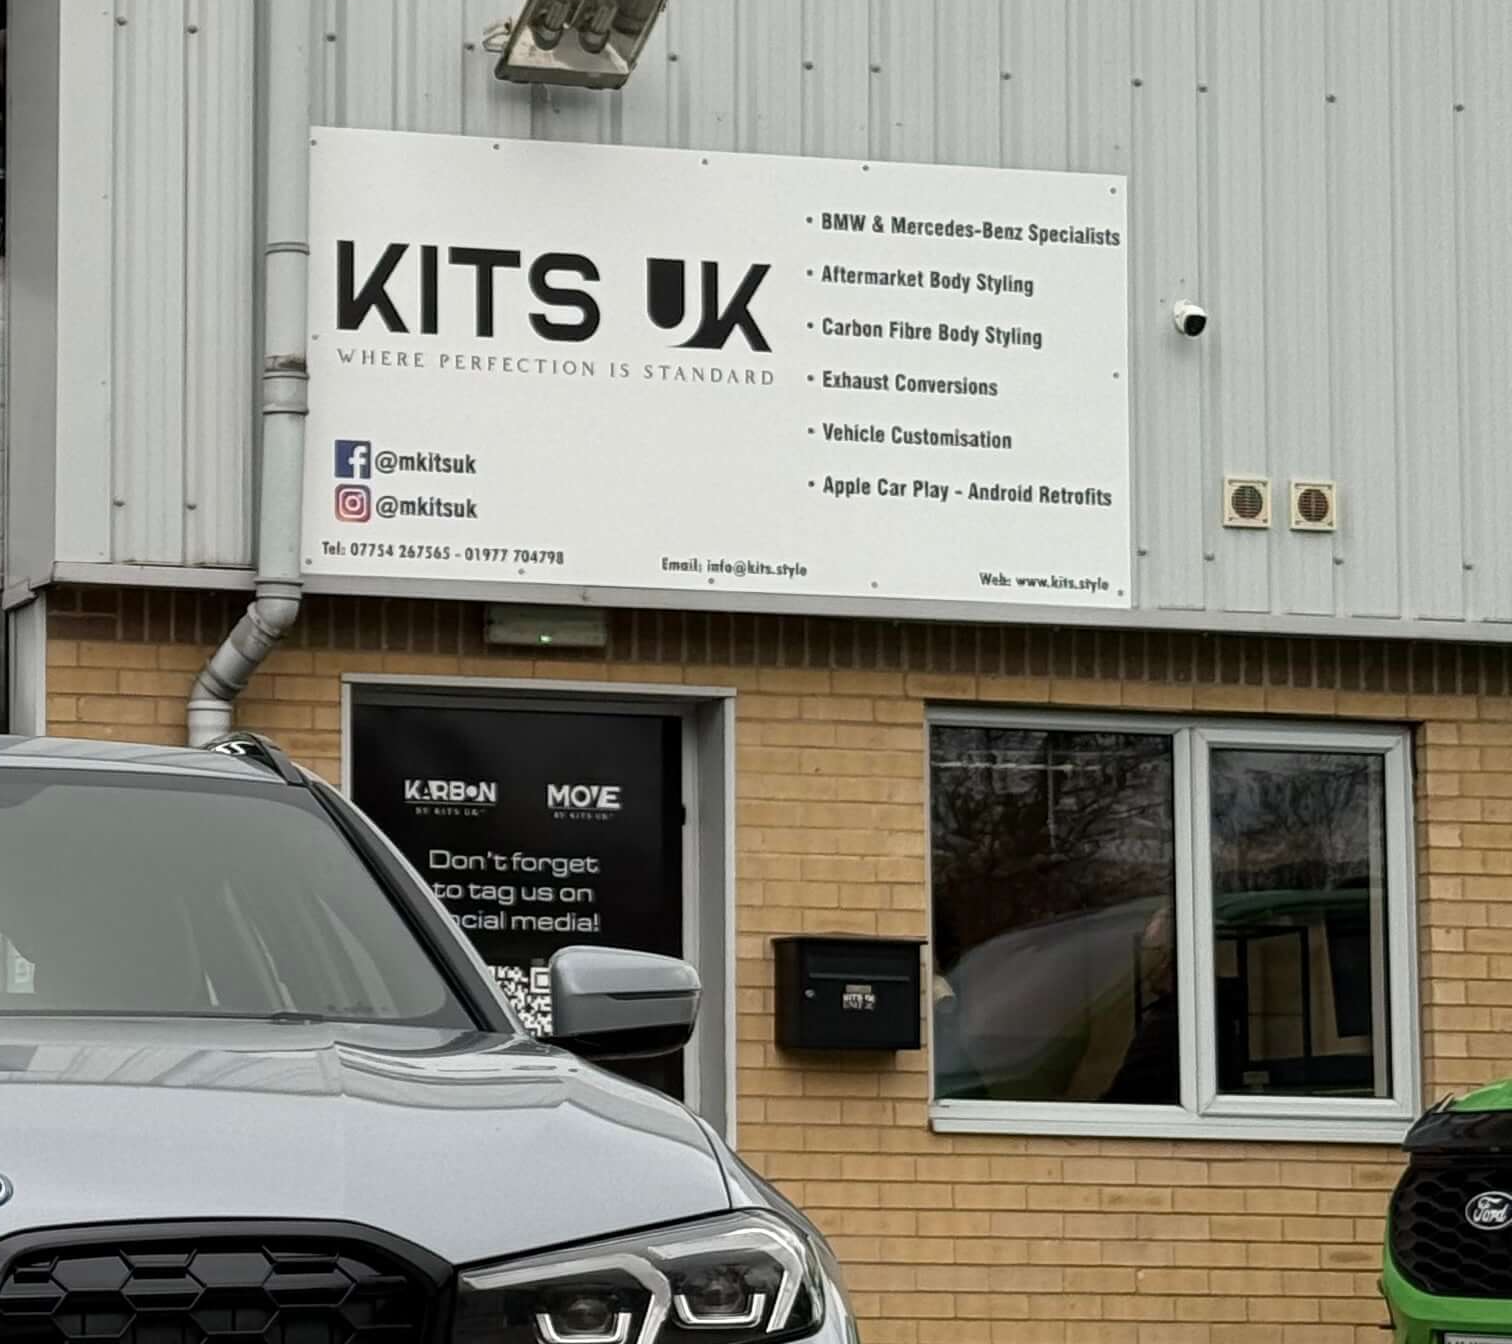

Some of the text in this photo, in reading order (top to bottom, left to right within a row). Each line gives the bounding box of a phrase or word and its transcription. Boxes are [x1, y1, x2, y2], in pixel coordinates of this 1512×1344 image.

[822, 213, 1121, 247] BMW & Mercedes-Benz Specialists
[821, 265, 1034, 298] Aftermarket Body Styling
[336, 239, 773, 353] KITS UK
[822, 317, 1042, 350] Carbon Fibre Body Styling
[337, 348, 775, 385] WHERE PERFECTION IS STANDARD
[822, 370, 998, 397] Exhaust Conversions
[822, 423, 1012, 449] Vehicle Customisation
[375, 450, 477, 474] @mkitsuk
[822, 476, 871, 498] Apple
[877, 477, 907, 497] Car
[913, 480, 949, 503] Play
[968, 483, 1033, 503] Android
[1039, 486, 1112, 507] Retrofits
[376, 495, 478, 519] @mkitsuk
[321, 541, 346, 556] Tel:
[350, 543, 394, 558] 07754
[398, 544, 450, 561] 267565
[464, 547, 508, 563] 01977
[513, 549, 565, 565] 704798
[707, 559, 808, 579] info@kits.style
[1016, 575, 1109, 593] www.kits.style
[404, 779, 497, 802] KARBON
[547, 783, 622, 809] MOVE
[429, 849, 600, 877] Don't forget
[432, 882, 593, 905] to tag us on
[511, 912, 600, 932] media!
[1472, 1196, 1510, 1224] Ford
